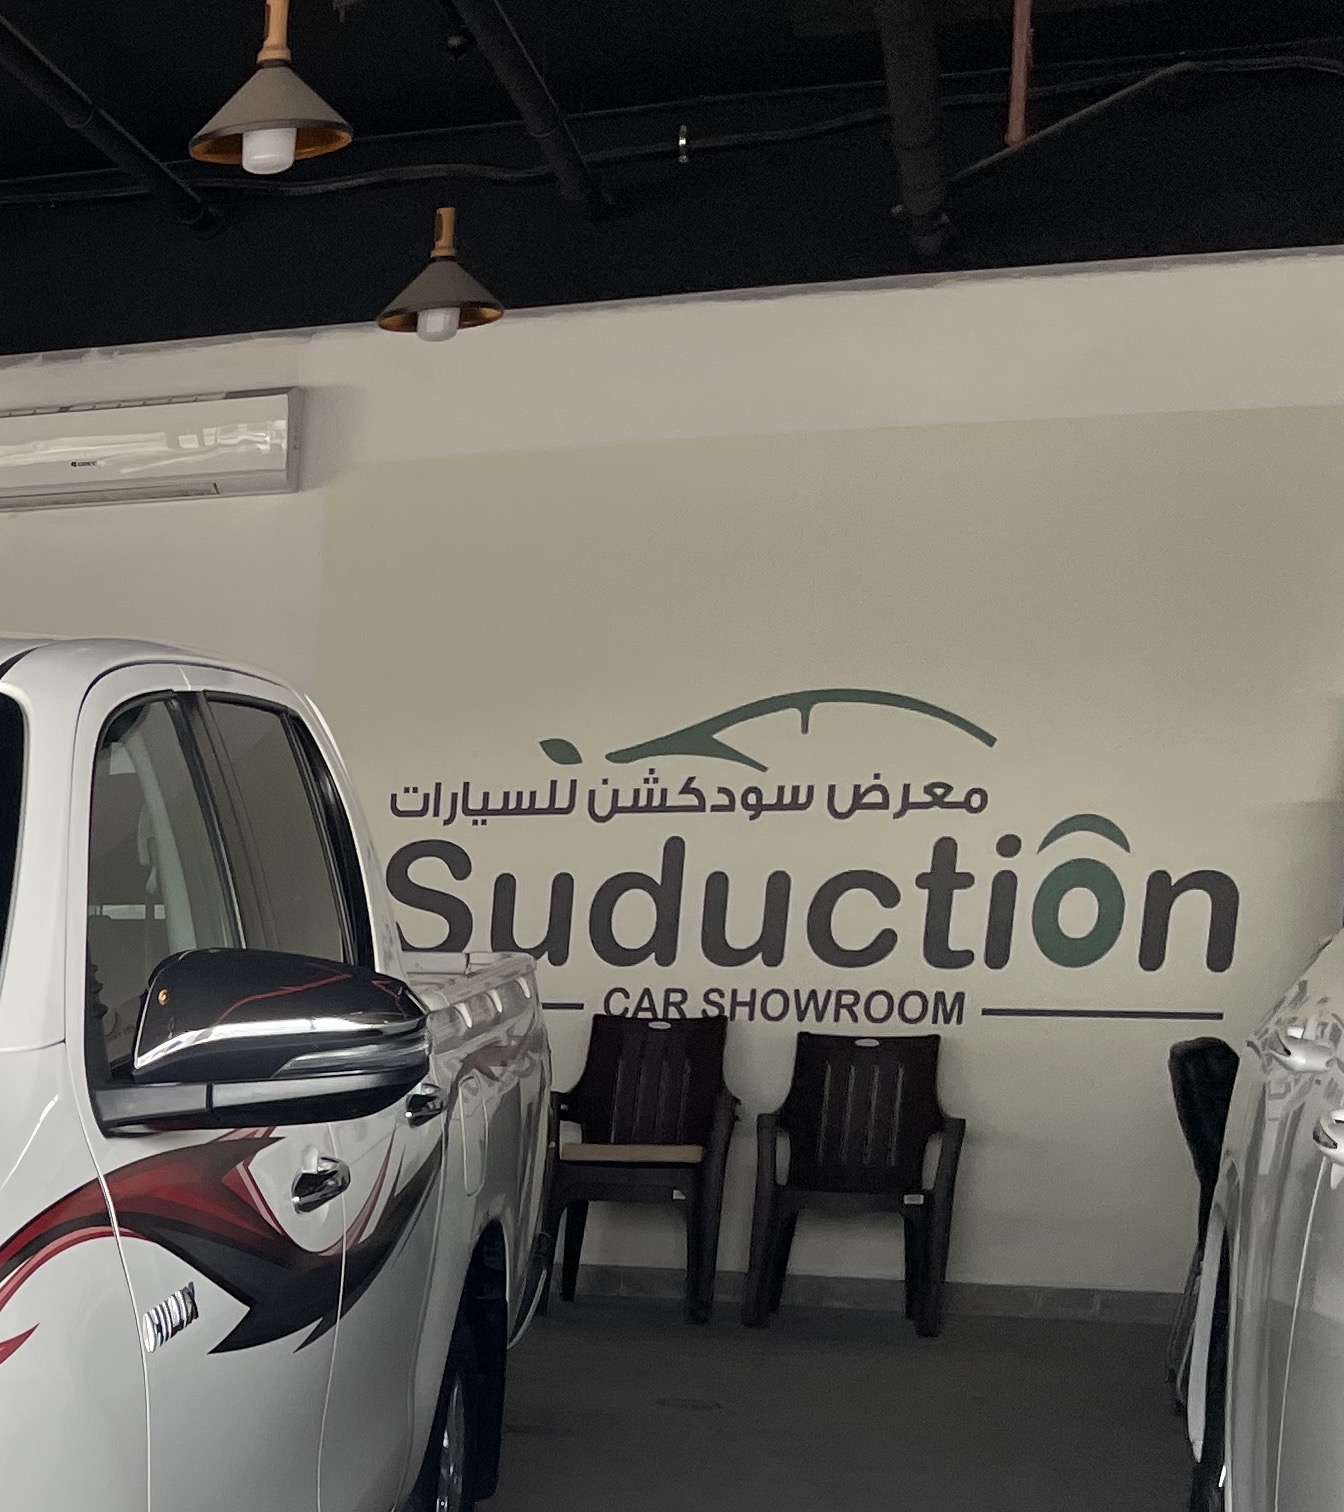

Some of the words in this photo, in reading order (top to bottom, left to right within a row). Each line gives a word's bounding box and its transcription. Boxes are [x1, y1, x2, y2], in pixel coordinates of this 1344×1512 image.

[389, 778, 579, 827] للسيارات
[587, 767, 815, 824] سودكشن
[826, 772, 989, 820] معرض
[384, 833, 1241, 975] Suduction
[603, 986, 689, 1019] CAR
[701, 987, 967, 1027] SHOWROOM
